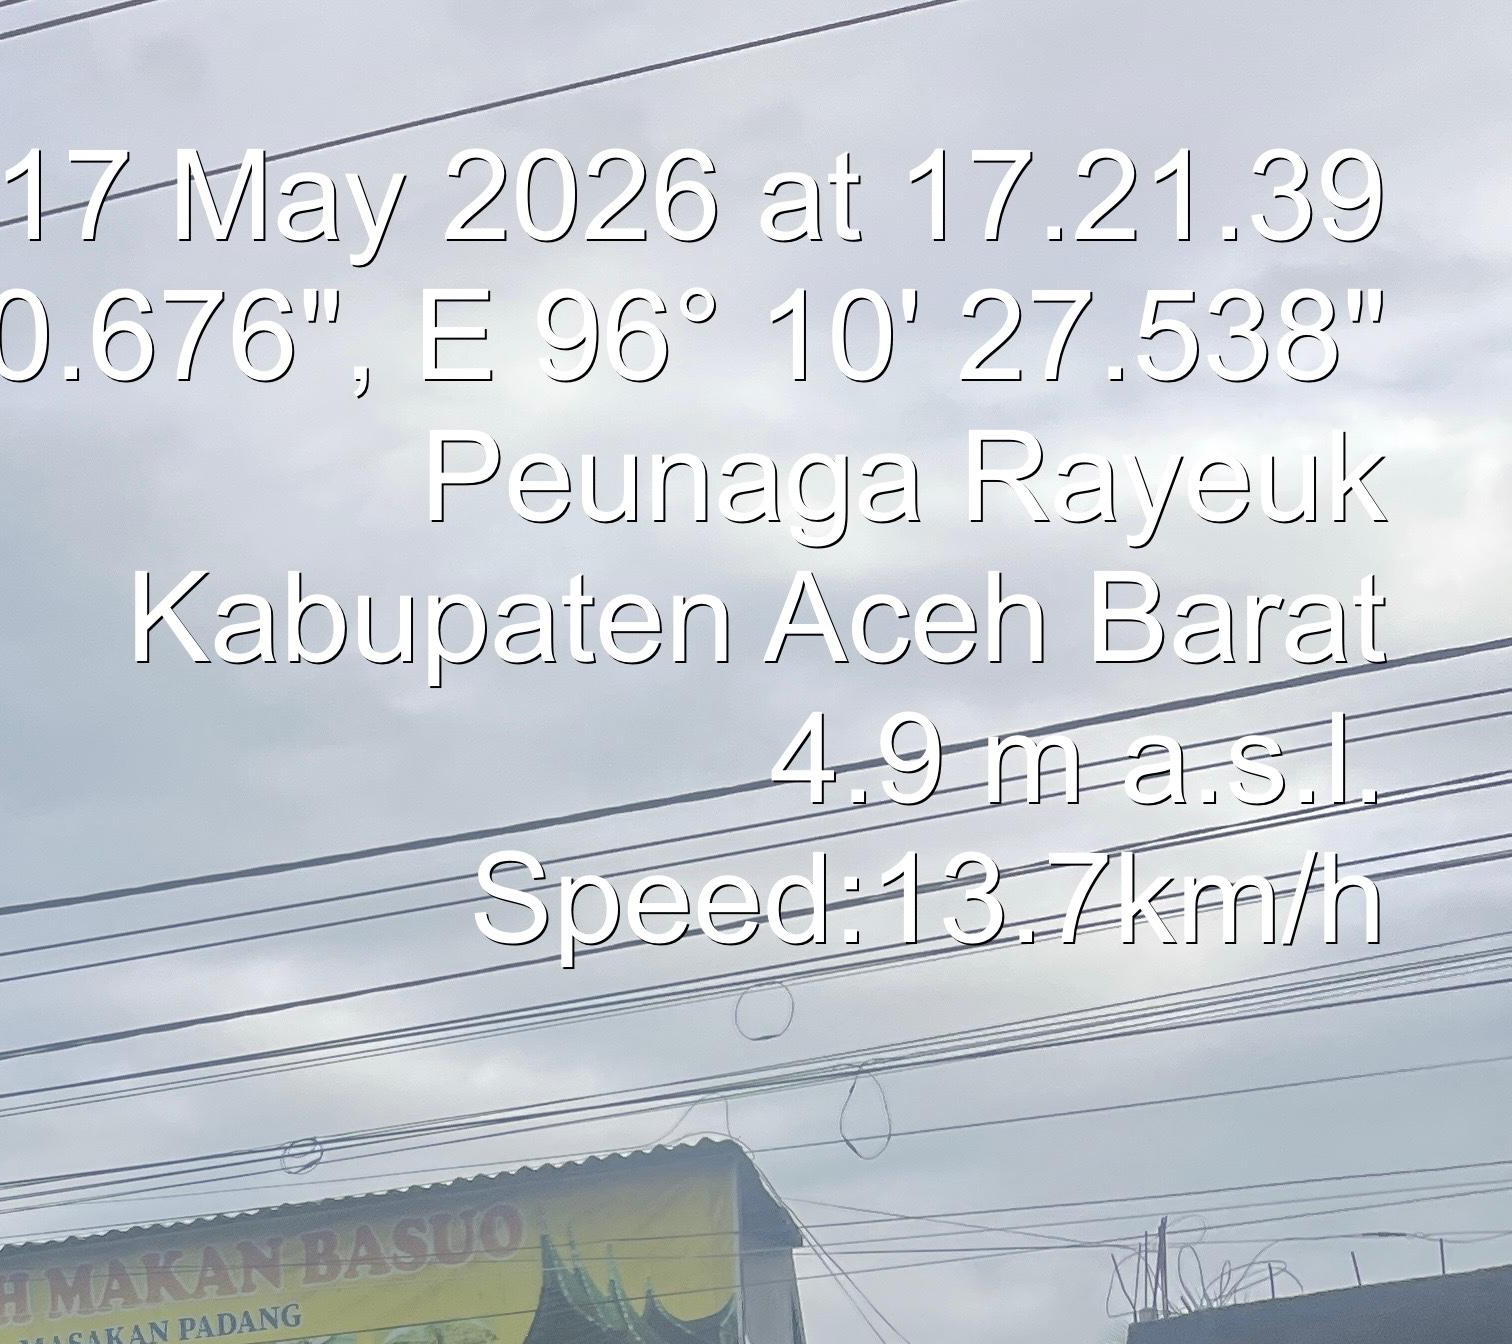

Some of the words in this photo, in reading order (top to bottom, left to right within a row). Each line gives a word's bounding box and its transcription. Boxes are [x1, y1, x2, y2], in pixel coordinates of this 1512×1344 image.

[45, 1236, 286, 1321] MAKAN
[298, 1202, 526, 1289] BASUO
[178, 1302, 304, 1342] PADANG
